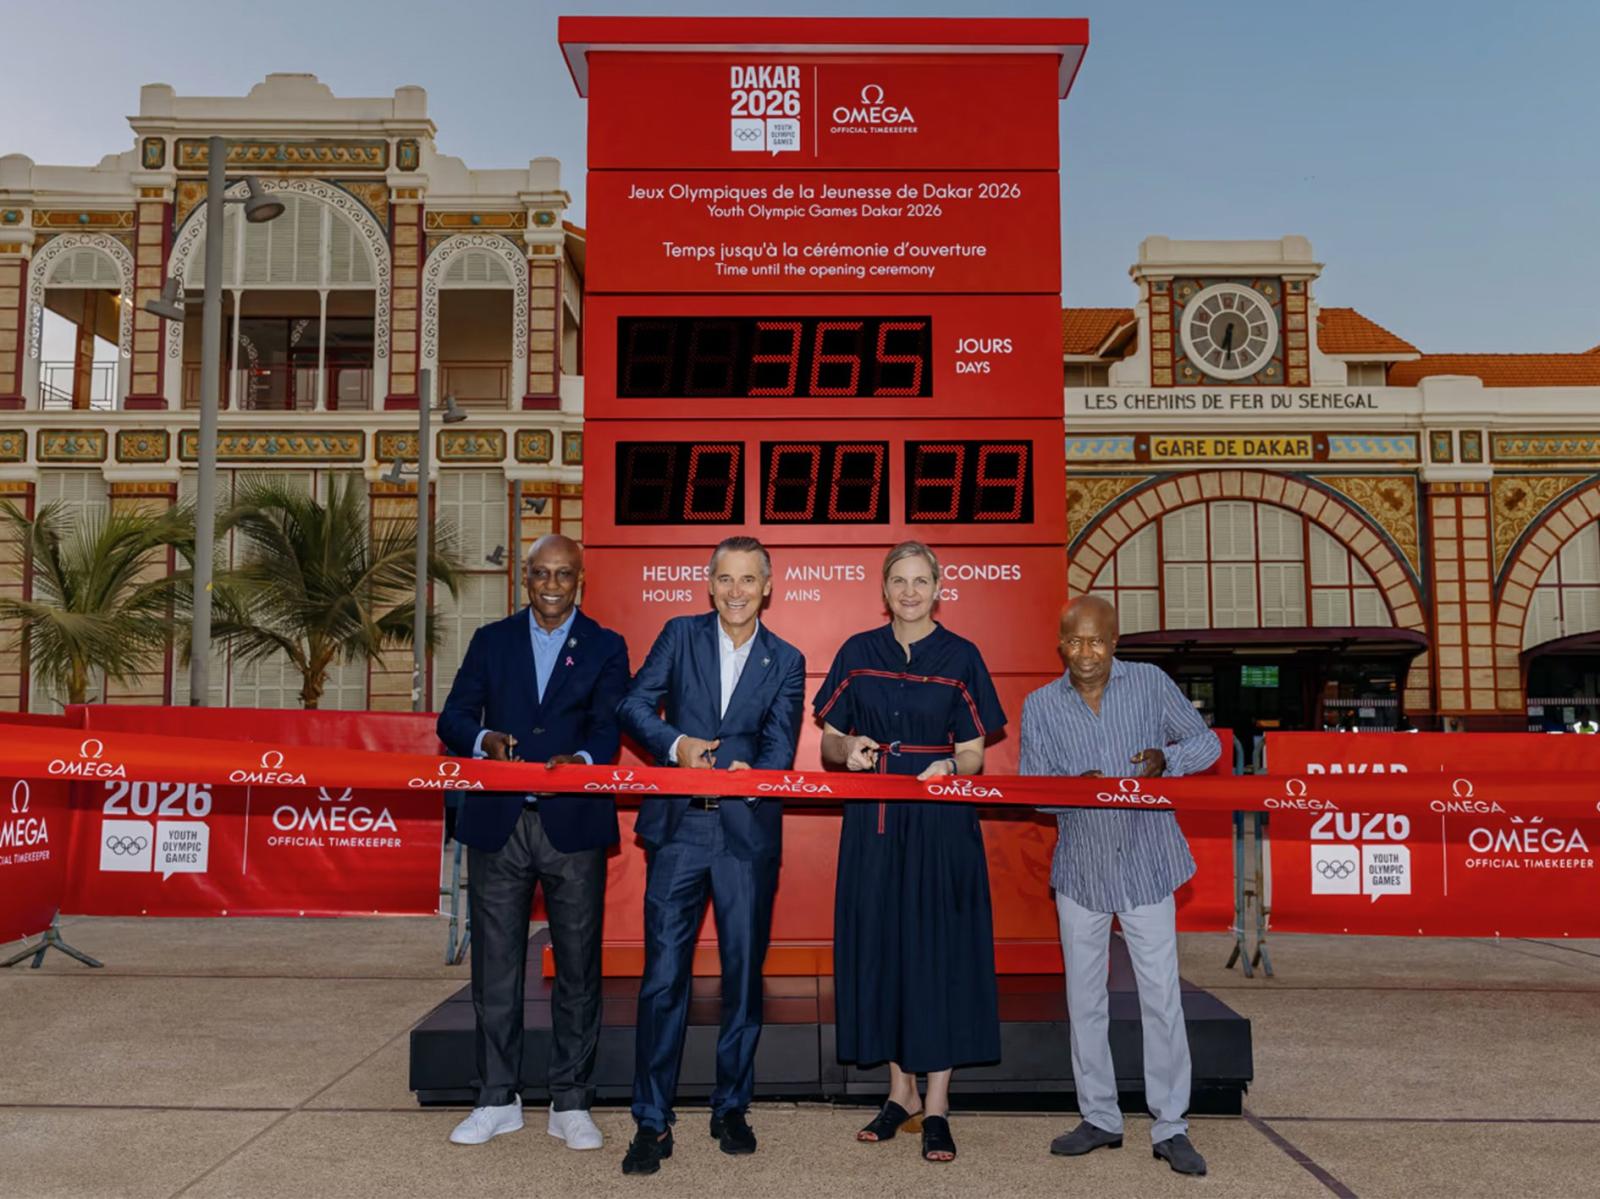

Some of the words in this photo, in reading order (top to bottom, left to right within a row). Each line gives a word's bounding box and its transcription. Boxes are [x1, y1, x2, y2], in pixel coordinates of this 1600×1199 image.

[730, 66, 800, 88] DAKAR
[731, 90, 801, 116] 2026
[833, 107, 914, 123] OMEGA
[830, 126, 867, 134] OFFICIAL
[870, 126, 918, 134] TIMEKEEPER
[628, 184, 665, 199] Jeux
[669, 184, 767, 202] Olympiques
[772, 184, 794, 198] de
[799, 184, 815, 198] la
[820, 184, 892, 198] Jeunesse
[897, 184, 918, 198] de
[923, 184, 973, 198] Dakar
[978, 183, 1021, 198] 2026
[707, 204, 744, 217] Youth
[748, 204, 806, 220] Olympic
[808, 204, 858, 217] Games
[862, 204, 902, 216] Dakar
[906, 204, 943, 216] 2026
[663, 242, 716, 261] Temps
[720, 242, 778, 261] jusqu'à
[783, 242, 798, 257] la
[803, 242, 889, 257] cérémonie
[715, 263, 748, 275] Time
[752, 263, 780, 275] until
[784, 263, 806, 275] the
[809, 264, 865, 278] opening
[869, 266, 935, 277] ceremony
[955, 338, 1013, 354] JOURS
[748, 322, 925, 396] 365
[955, 361, 991, 374] DAYS
[1085, 394, 1118, 409] LES
[1123, 394, 1196, 409] CHEMINS
[1202, 394, 1224, 409] DE
[1230, 394, 1264, 409] FER
[1271, 394, 1292, 408] DU
[1299, 394, 1379, 409] SENEGAL
[1155, 440, 1207, 456] GARE
[1213, 440, 1237, 456] DE
[1243, 440, 1309, 456] DAKAR
[765, 445, 884, 520] 00
[911, 445, 1028, 520] 39
[642, 566, 709, 581] HEURES
[785, 565, 865, 581] MINUTES
[940, 565, 1022, 580] CONDES
[642, 589, 693, 602] HOURS
[785, 589, 821, 601] MINS
[939, 588, 959, 601] CS
[48, 759, 126, 778] OMEGA
[229, 770, 307, 785] OMEGA
[408, 778, 484, 790] OMEGA
[584, 783, 659, 791] OMEGA
[757, 783, 832, 793] OMEGA
[928, 784, 1003, 797] OMEGA
[103, 780, 212, 817] 2026
[1097, 793, 1172, 805] OMEGA
[1264, 799, 1340, 810] OMEGA
[1430, 800, 1506, 813] OMEGA
[273, 806, 398, 832] OMEGA
[1310, 812, 1410, 840] 2026
[0, 818, 49, 848] MEGA
[168, 831, 198, 840] YOUTH
[1469, 828, 1589, 853] OMEGA
[162, 842, 202, 851] OLYMPIC
[267, 837, 325, 847] OFFICIAL
[329, 837, 402, 847] TIMEKEEPER
[165, 853, 198, 863] GAMES
[1373, 853, 1399, 862] YOUTH
[1465, 859, 1521, 868] OFFICIAL
[1524, 859, 1594, 868] TIMEKEEPER
[1369, 865, 1404, 874] OLYMPIC
[1373, 876, 1401, 886] GAMES
